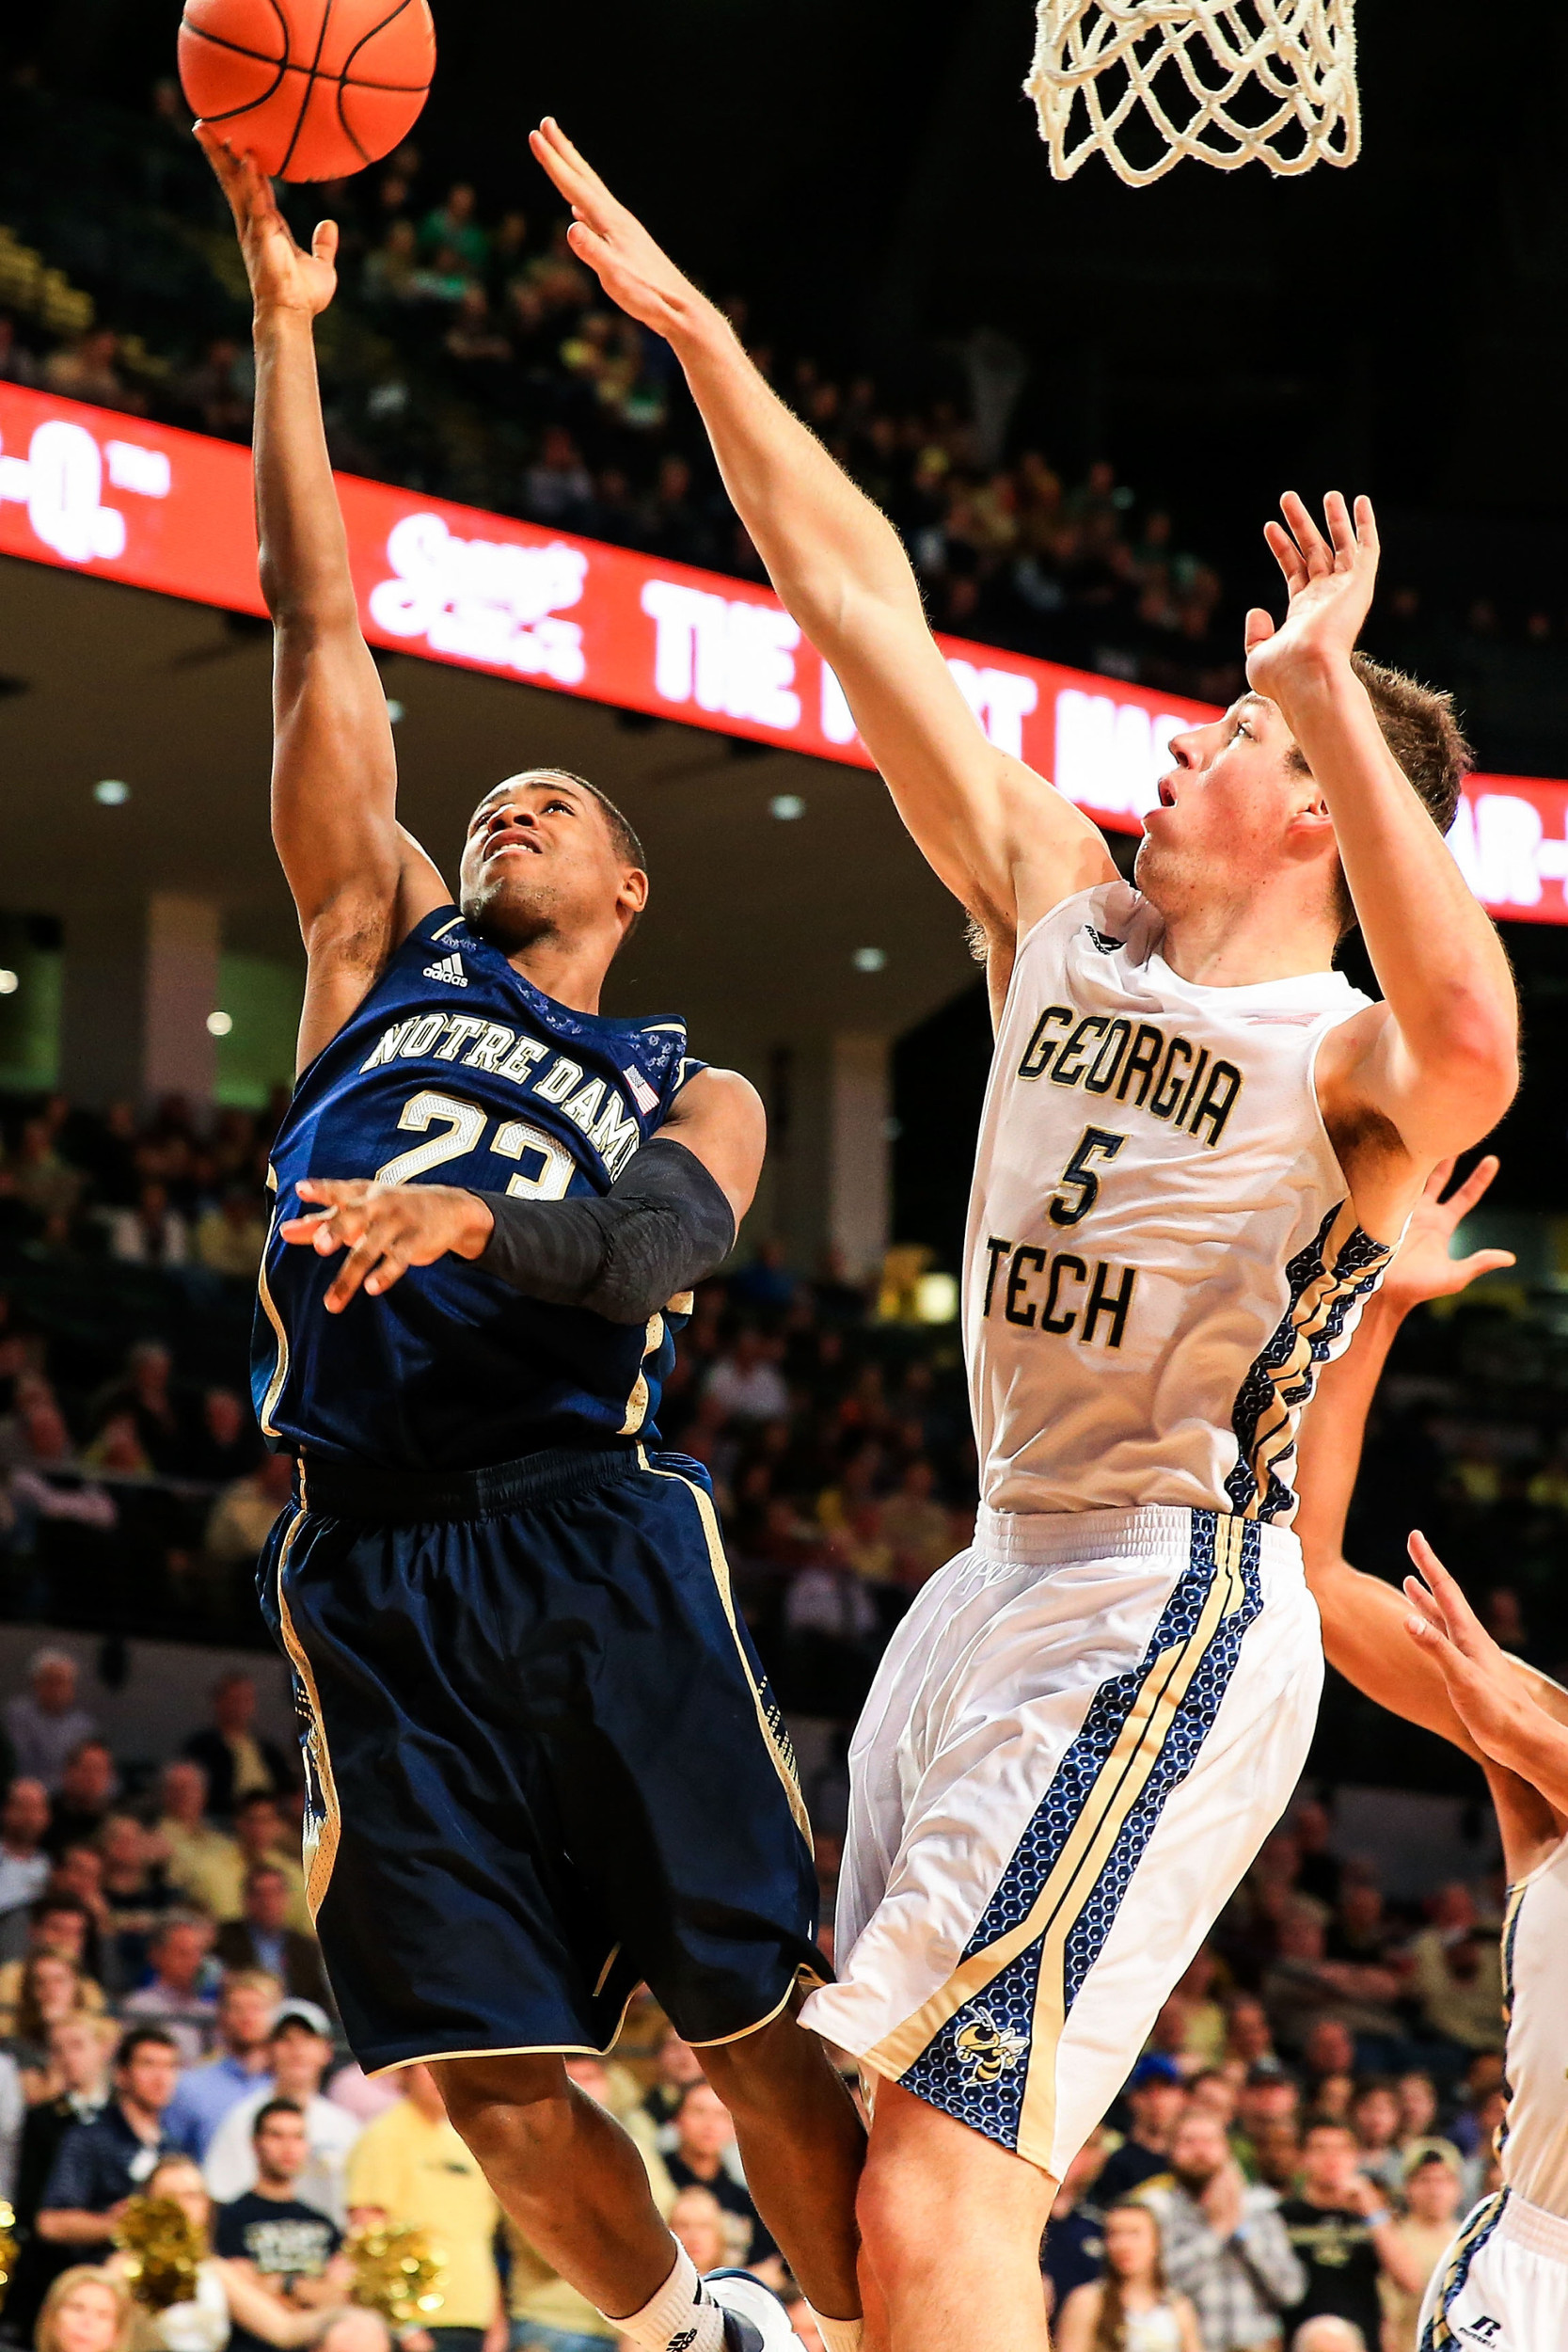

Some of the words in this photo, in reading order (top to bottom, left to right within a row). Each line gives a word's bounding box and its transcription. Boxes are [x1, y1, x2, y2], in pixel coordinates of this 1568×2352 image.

[641, 580, 800, 729] THE
[422, 967, 468, 988] adidas
[358, 1012, 550, 1085] NOTRE
[1017, 1003, 1244, 1151] GEORGIA
[375, 1089, 578, 1202] 23
[1047, 1123, 1130, 1230] 5
[982, 1233, 1139, 1352] TECH
